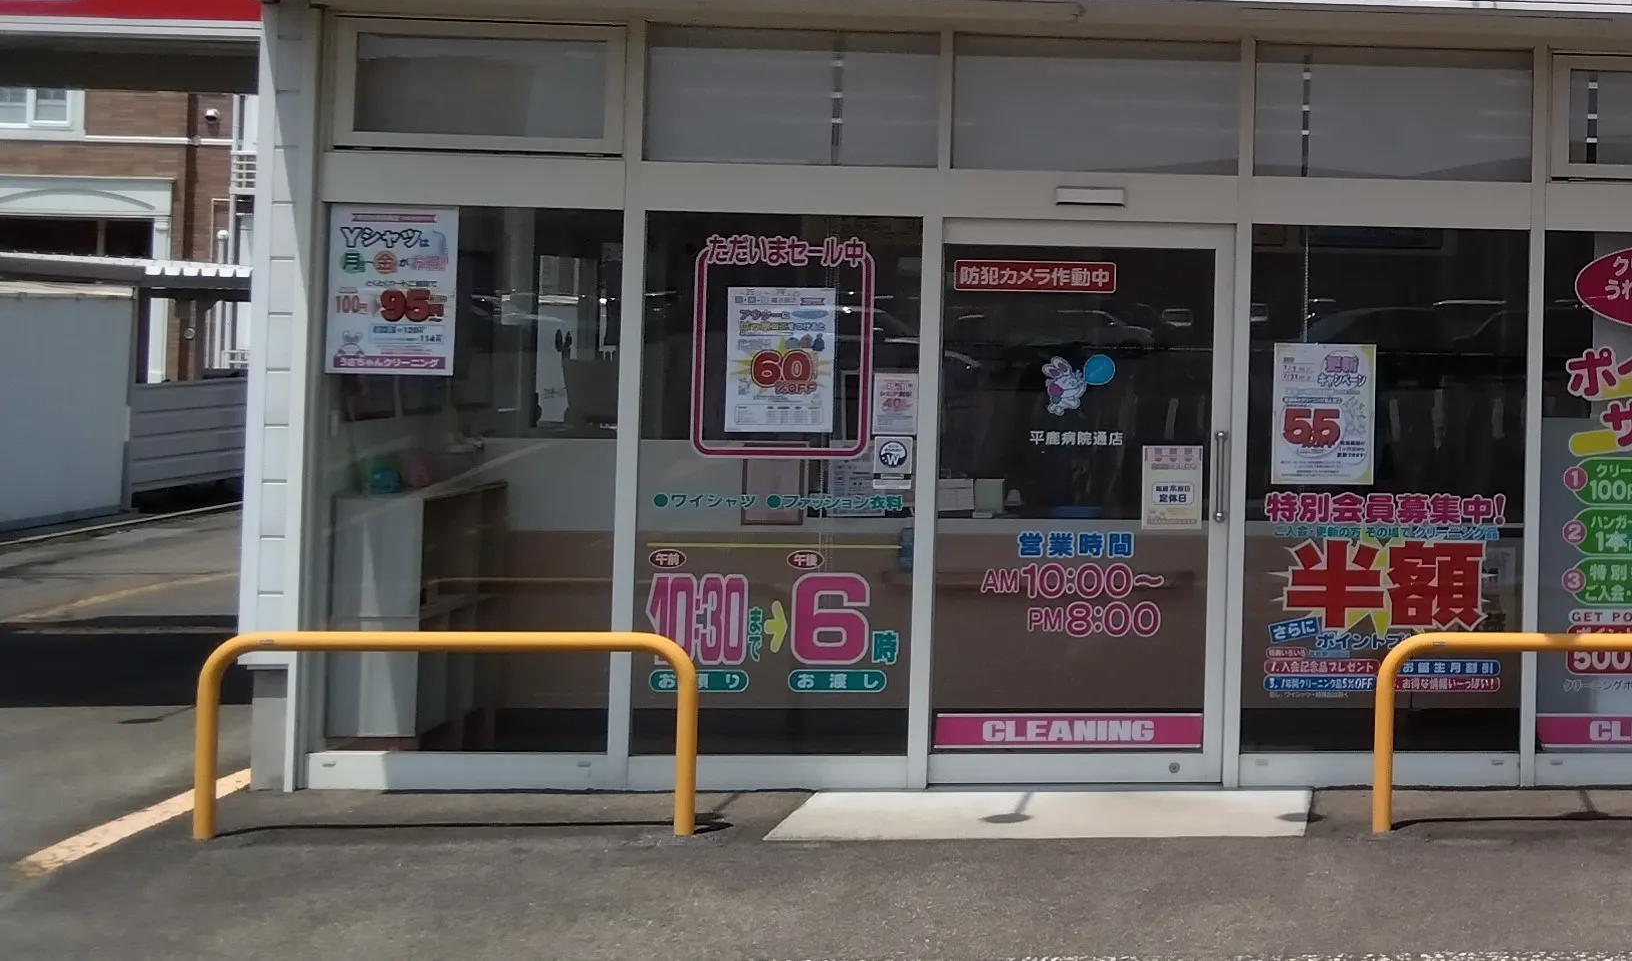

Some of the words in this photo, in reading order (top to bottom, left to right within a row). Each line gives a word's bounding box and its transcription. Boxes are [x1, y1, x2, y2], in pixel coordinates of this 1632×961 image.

[706, 235, 866, 267] ただいまセール中
[959, 266, 1111, 287] 防犯カメラ作動中
[750, 348, 814, 388] 60
[1317, 371, 1368, 388] キャンペーン
[1029, 429, 1125, 447] 平鹿病院通店
[1264, 491, 1507, 526] 特別会員募集中!
[1017, 530, 1135, 558] 営業時間
[655, 552, 680, 566] 午前
[793, 554, 818, 567] 午後
[1283, 538, 1487, 631] 半額
[790, 572, 871, 665] 6
[1571, 612, 1602, 623] GET
[748, 606, 764, 663] まで
[1272, 620, 1318, 640] さらに
[871, 630, 899, 664] 時
[797, 673, 880, 690] お渡し
[982, 720, 1155, 742] CLEANING
